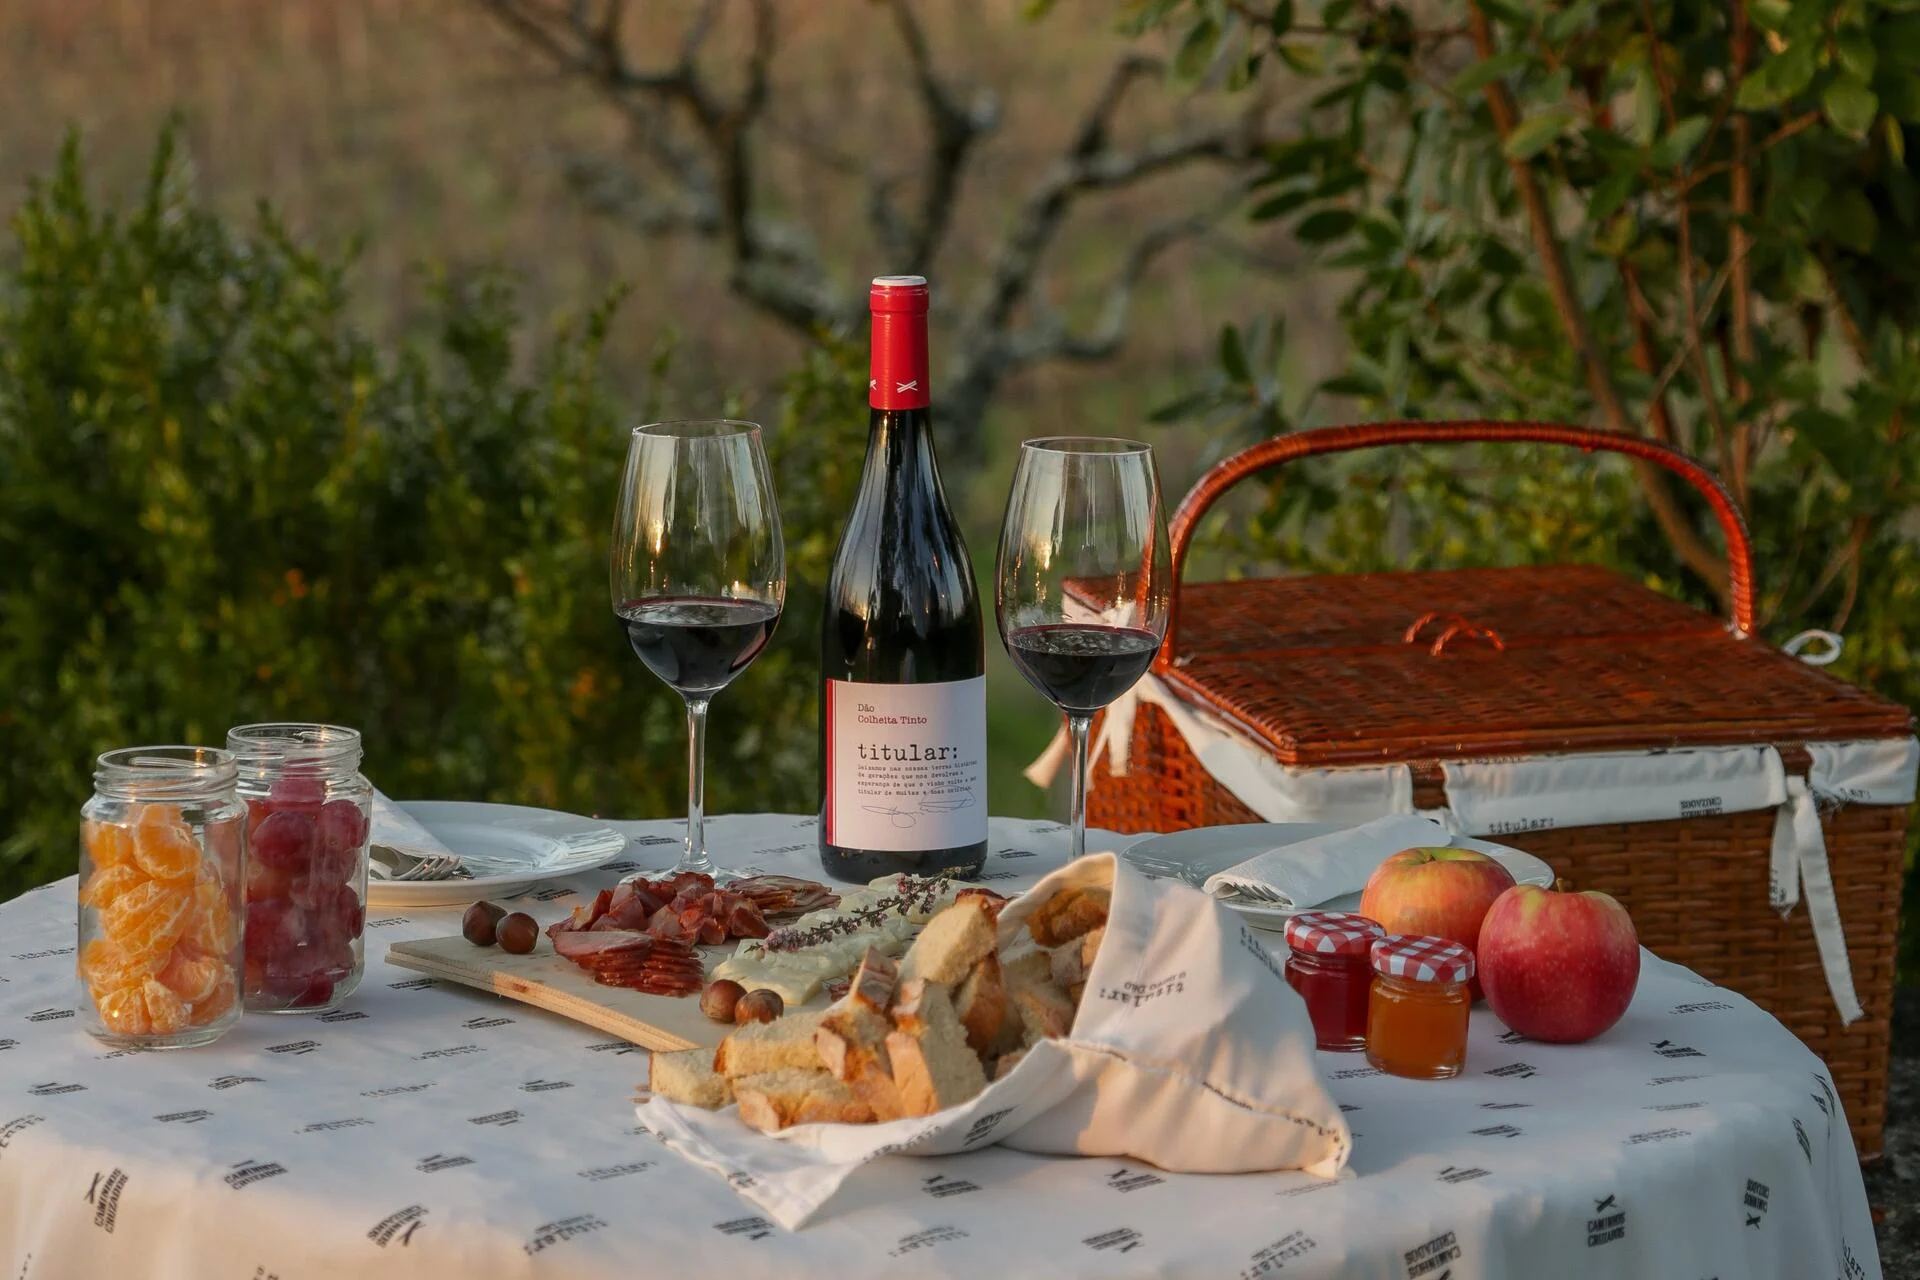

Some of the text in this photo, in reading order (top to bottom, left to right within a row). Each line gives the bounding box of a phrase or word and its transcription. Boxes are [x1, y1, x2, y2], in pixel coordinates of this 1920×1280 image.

[857, 703, 875, 713] Dão
[857, 714, 928, 725] Colheita Tinto
[857, 743, 958, 762] titular:
[1488, 817, 1555, 834] titular:
[93, 1167, 122, 1228] CAMINHOS
[104, 1173, 130, 1234] CRUZADOS
[1586, 1211, 1626, 1233] CAMINHOS
[1586, 1226, 1626, 1248] CRUZADOS
